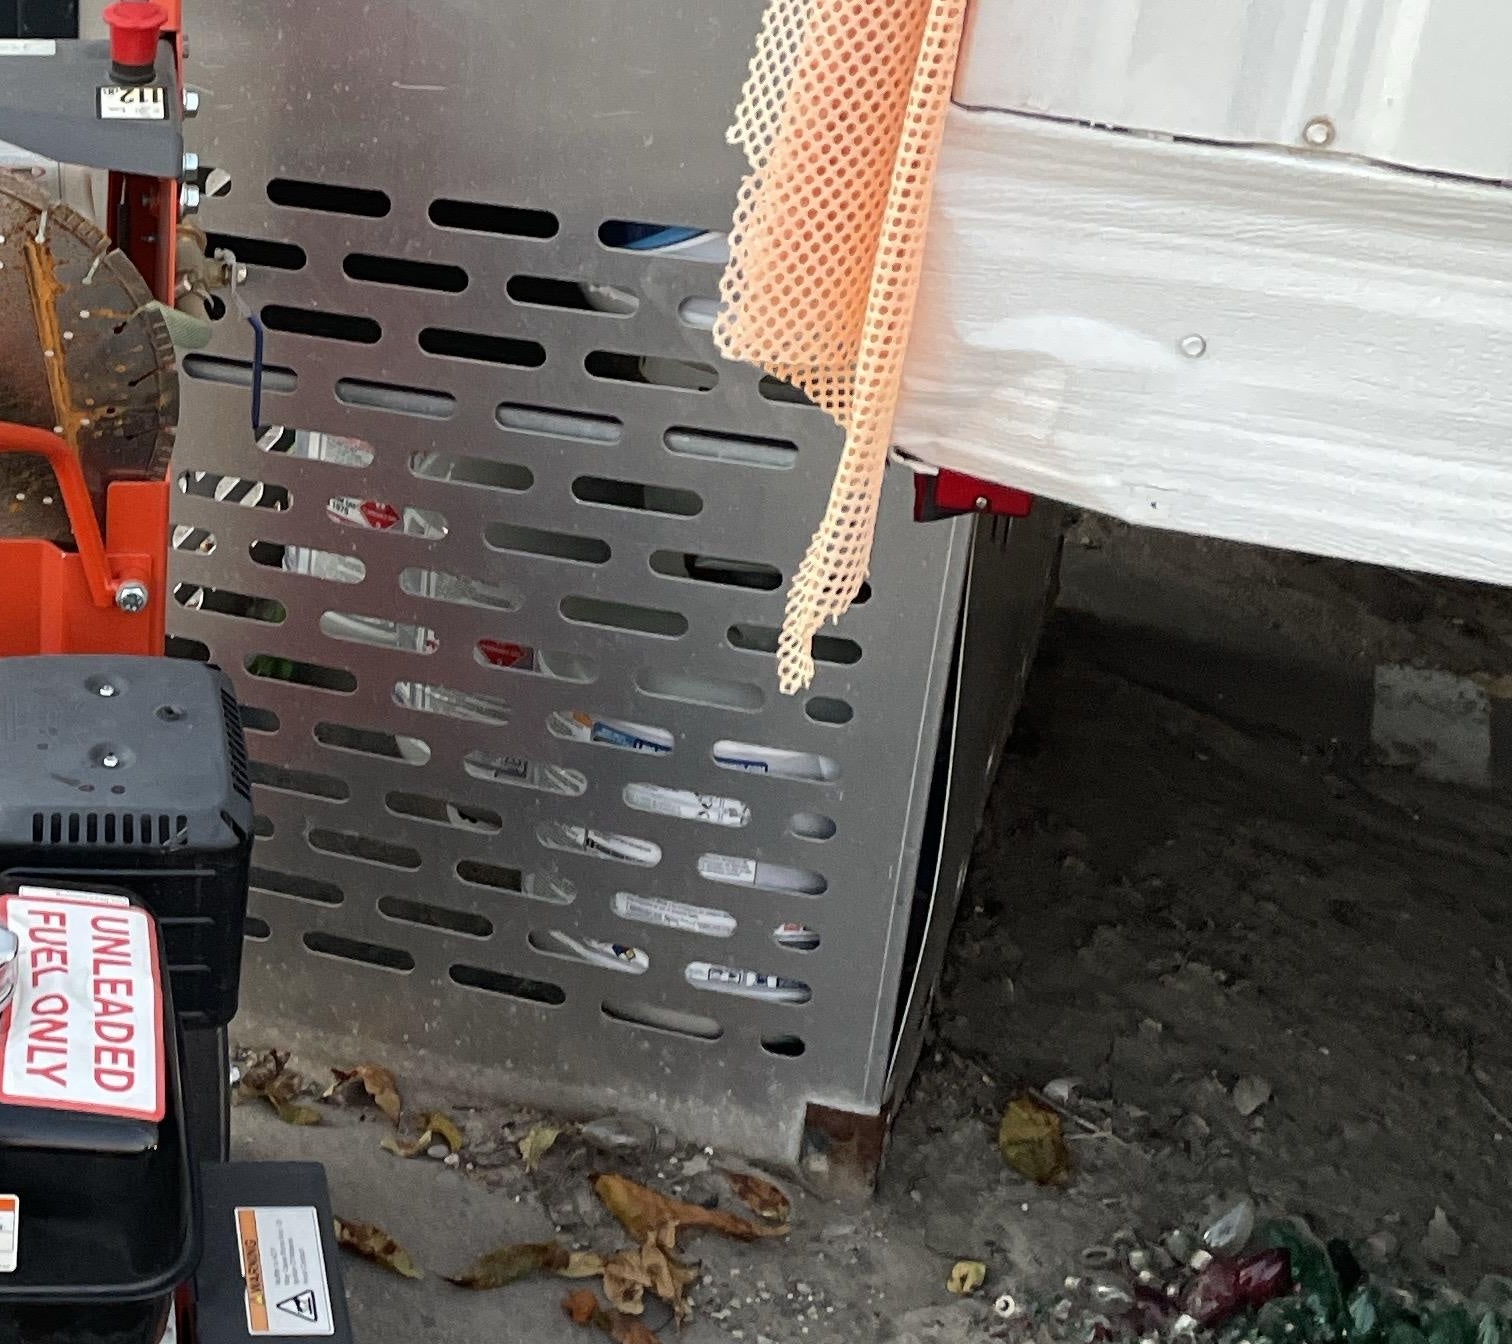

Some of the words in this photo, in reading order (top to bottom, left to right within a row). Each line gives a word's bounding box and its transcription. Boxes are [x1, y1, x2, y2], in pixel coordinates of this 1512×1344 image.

[28, 909, 69, 989] FUEL
[26, 992, 69, 1088] ONLY
[90, 915, 135, 1093] UNLEADED
